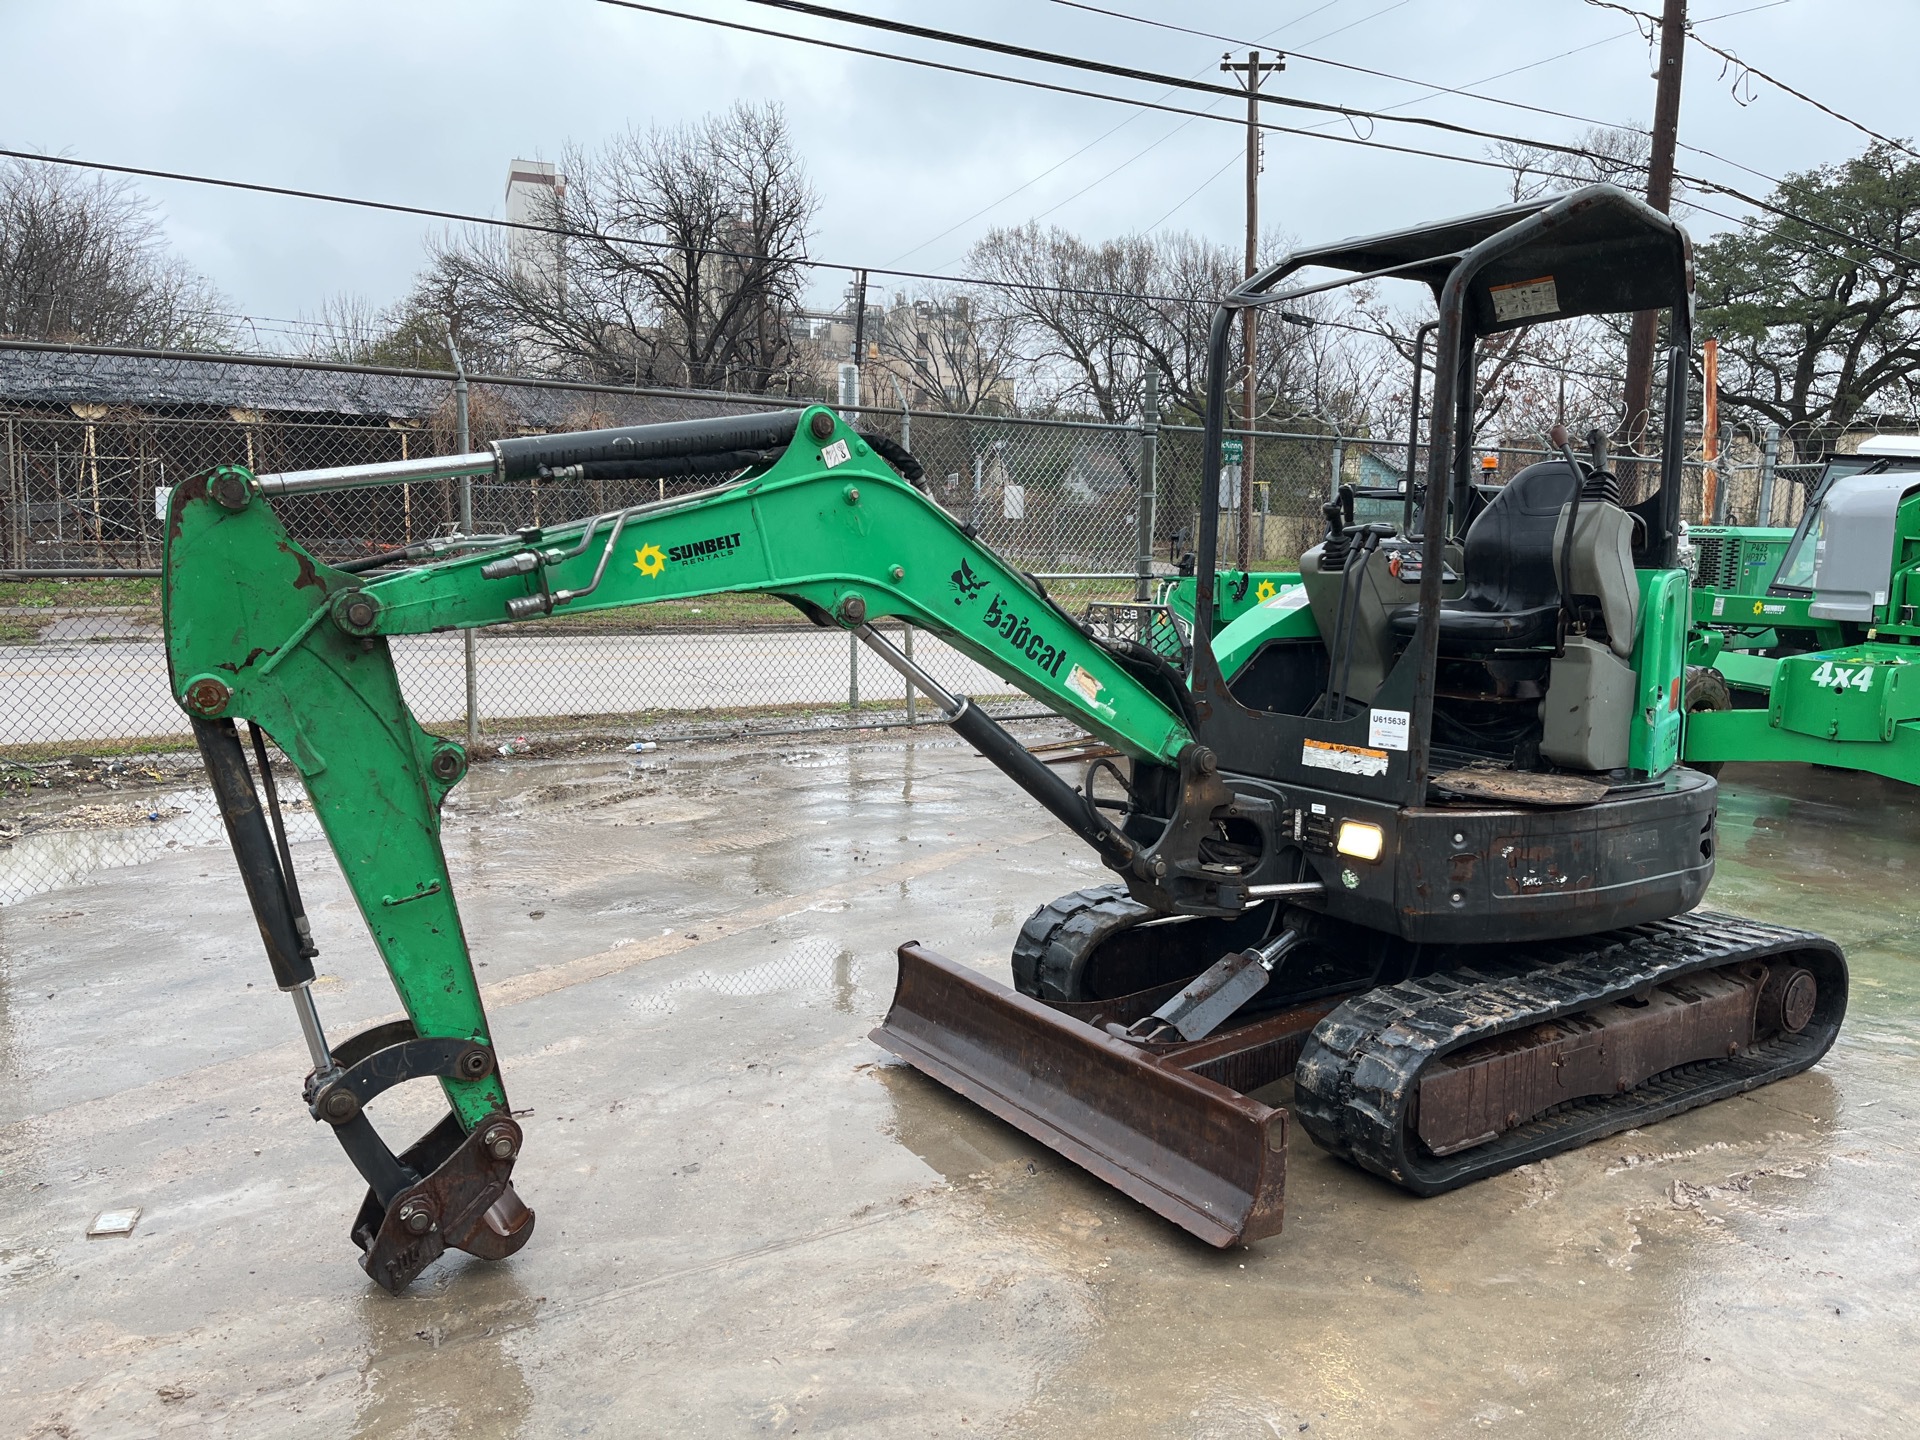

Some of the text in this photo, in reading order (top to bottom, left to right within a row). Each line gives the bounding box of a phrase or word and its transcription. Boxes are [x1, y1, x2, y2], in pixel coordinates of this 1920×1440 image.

[668, 533, 741, 562] SUNBELT
[1751, 543, 1768, 553] P425
[682, 550, 734, 566] RENTALS
[1810, 661, 1875, 692] 4x4
[1373, 715, 1406, 726] U615638
[1335, 745, 1361, 755] WARNING
